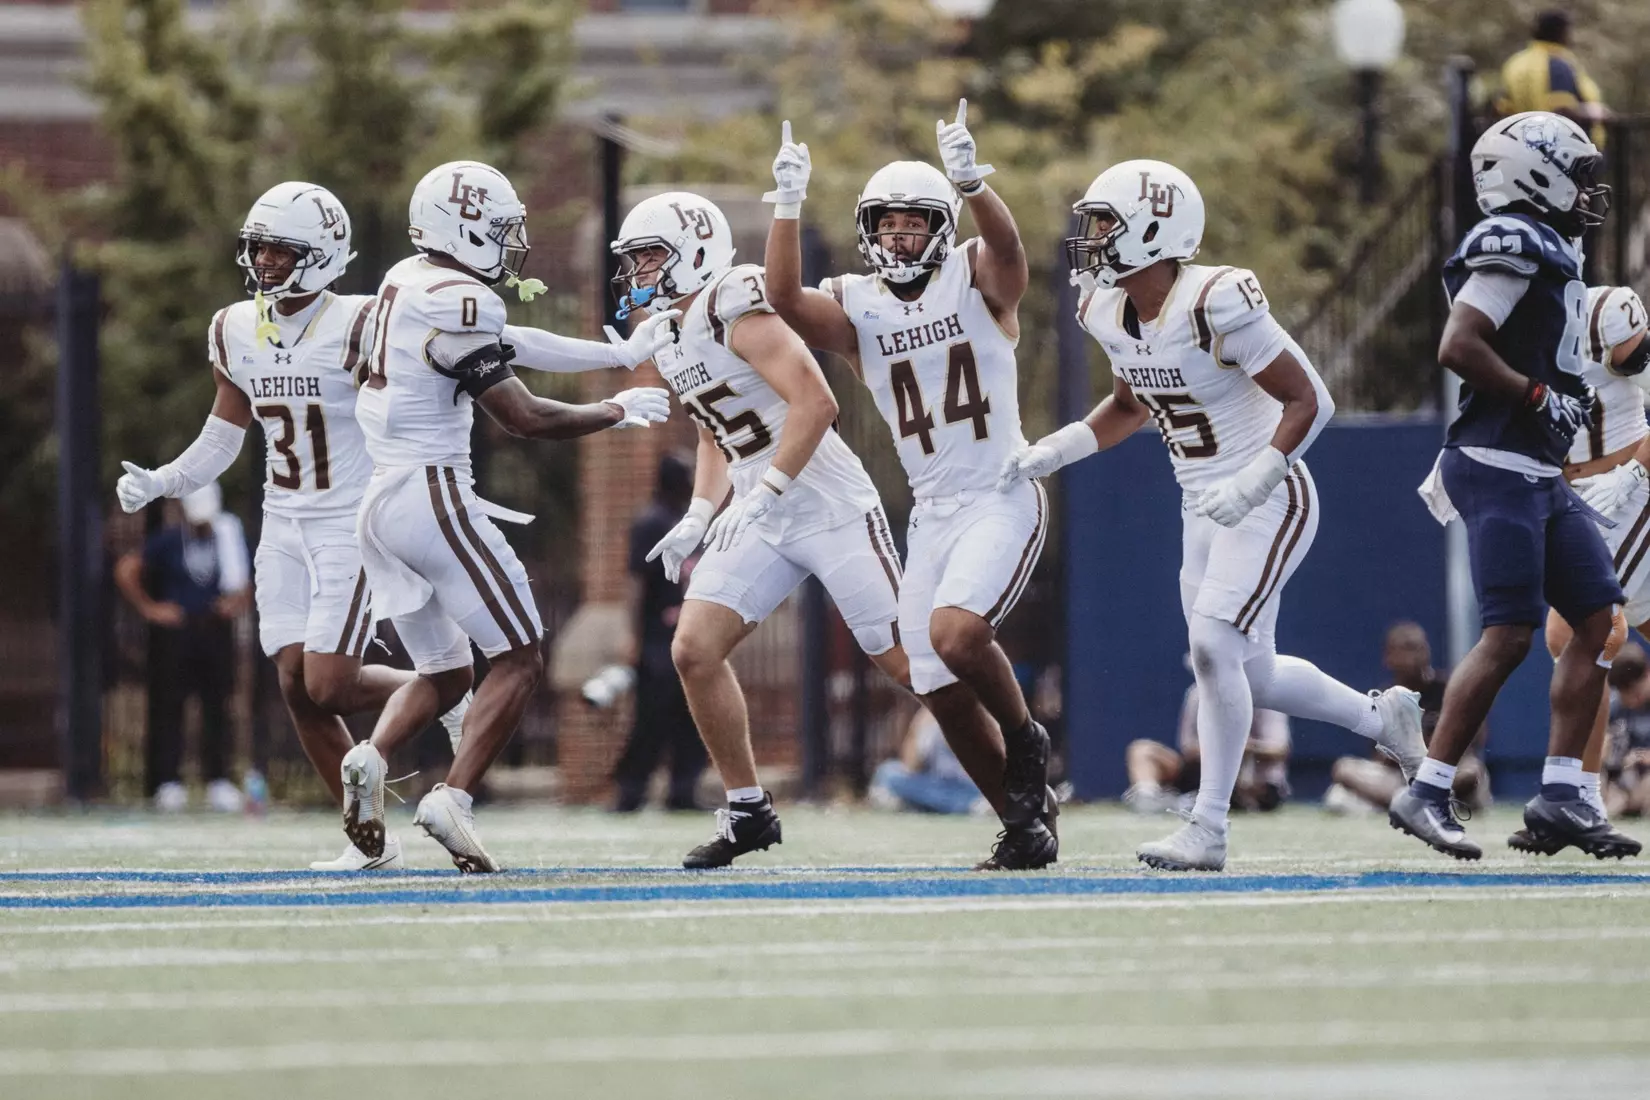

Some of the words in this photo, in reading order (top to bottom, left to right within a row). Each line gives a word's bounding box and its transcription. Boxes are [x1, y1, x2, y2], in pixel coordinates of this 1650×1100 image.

[449, 173, 488, 221] LU
[1139, 172, 1175, 218] LU
[311, 197, 346, 241] LU
[669, 202, 713, 240] LU
[462, 297, 478, 327] 0
[1236, 277, 1265, 310] 15
[876, 313, 964, 357] LEHIGH
[250, 376, 322, 398] LEHIGH
[890, 340, 991, 455] 44
[1120, 367, 1187, 389] LEHIGH
[254, 403, 331, 490] 31
